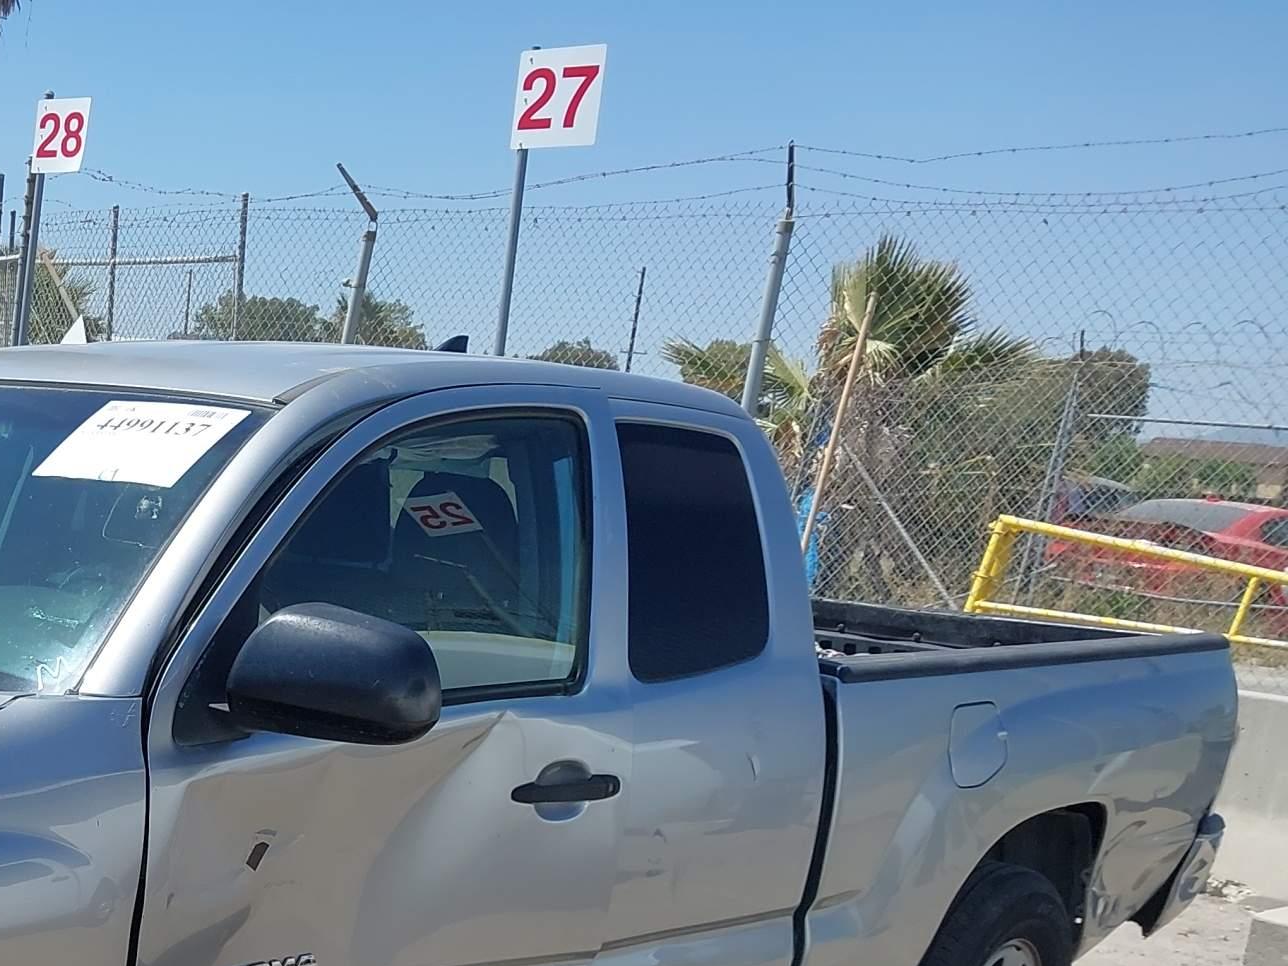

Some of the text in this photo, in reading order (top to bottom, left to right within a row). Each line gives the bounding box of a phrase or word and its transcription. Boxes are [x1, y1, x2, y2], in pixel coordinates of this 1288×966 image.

[517, 65, 600, 130] 27
[36, 112, 84, 158] 28
[97, 417, 212, 437] 44991137
